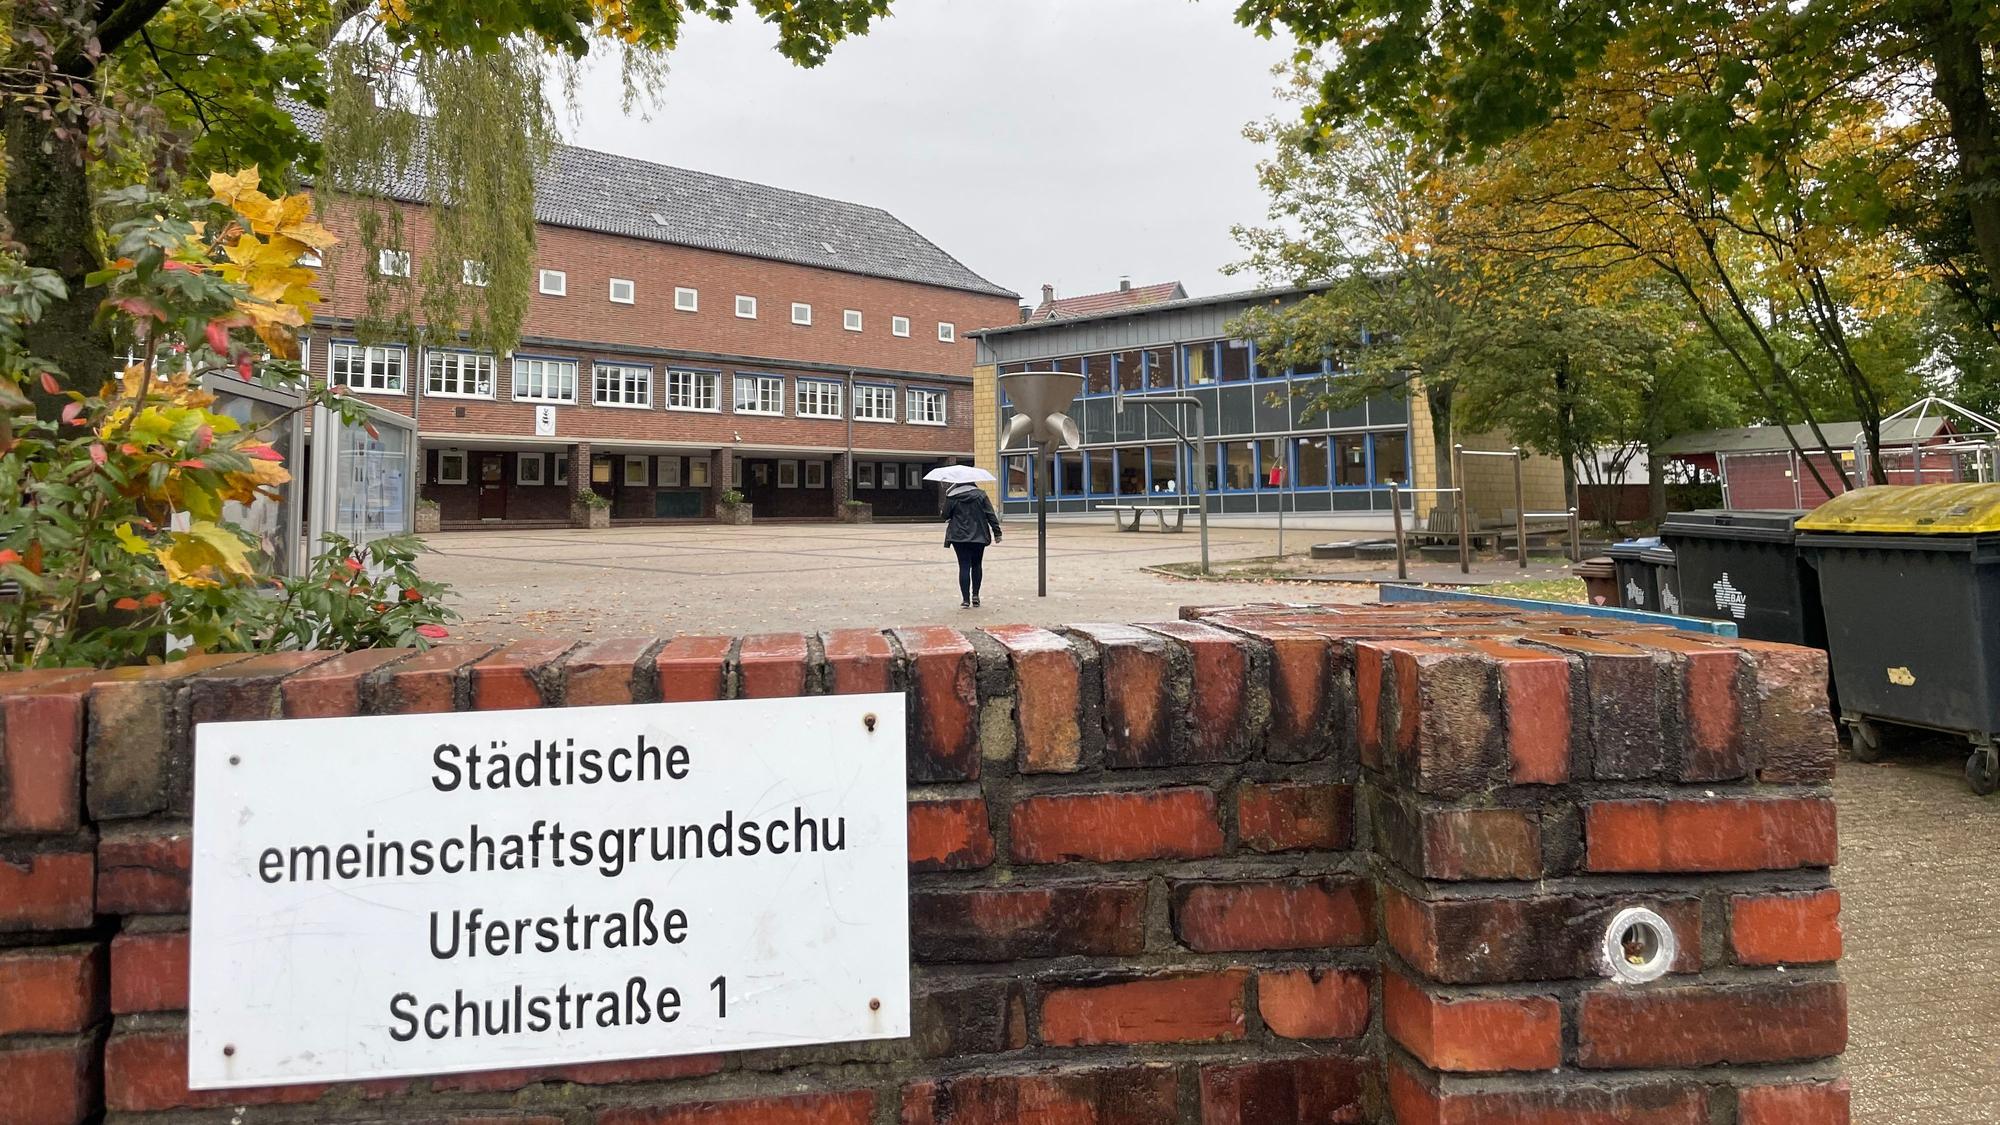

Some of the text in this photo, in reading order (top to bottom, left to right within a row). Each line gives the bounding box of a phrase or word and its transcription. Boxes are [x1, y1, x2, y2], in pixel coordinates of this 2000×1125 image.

[1730, 594, 1746, 603] BAV
[431, 735, 690, 792] Städtische
[258, 806, 846, 884] emeinschaftsgrundschu
[430, 898, 689, 960] Uferstraße
[389, 975, 728, 1042] Schulstraße 1
